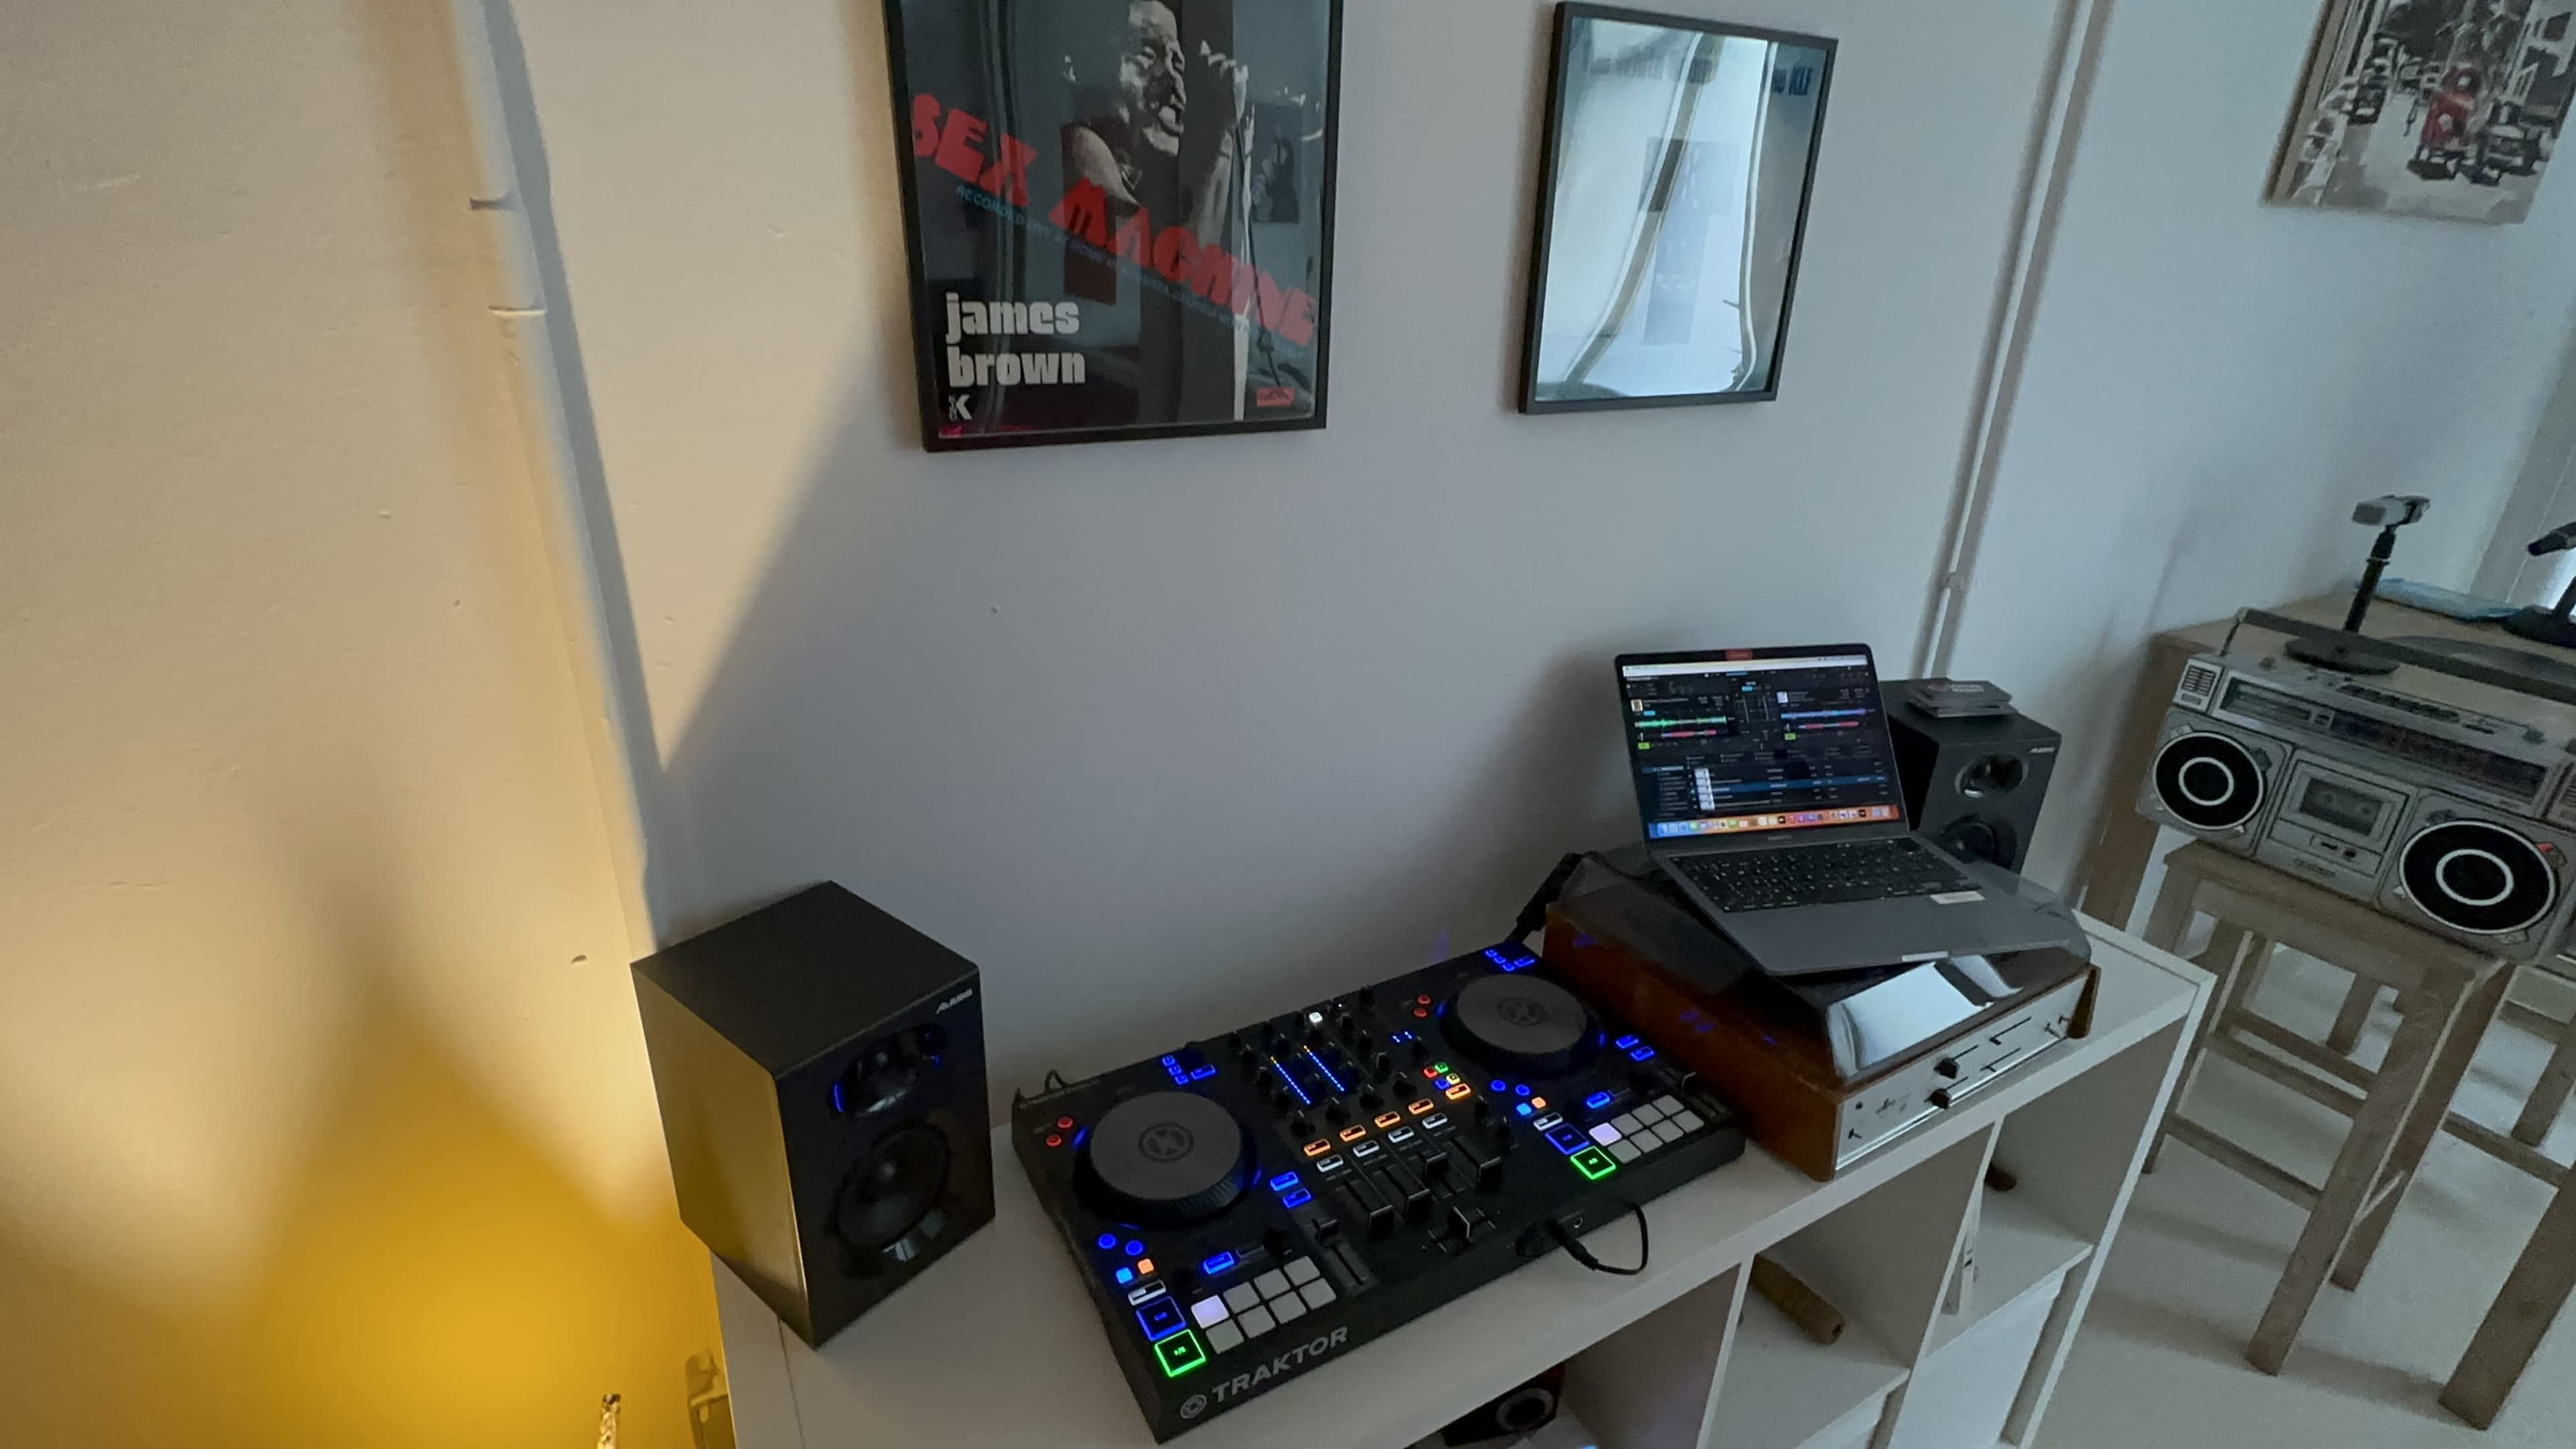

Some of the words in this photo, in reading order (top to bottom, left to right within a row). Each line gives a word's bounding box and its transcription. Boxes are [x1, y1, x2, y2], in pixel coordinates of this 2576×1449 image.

[912, 93, 1036, 207] SEX
[1049, 177, 1316, 347] MACHINE
[945, 292, 1079, 343] james
[947, 345, 1085, 388] brown
[1212, 1326, 1348, 1403] TRAKTOR
